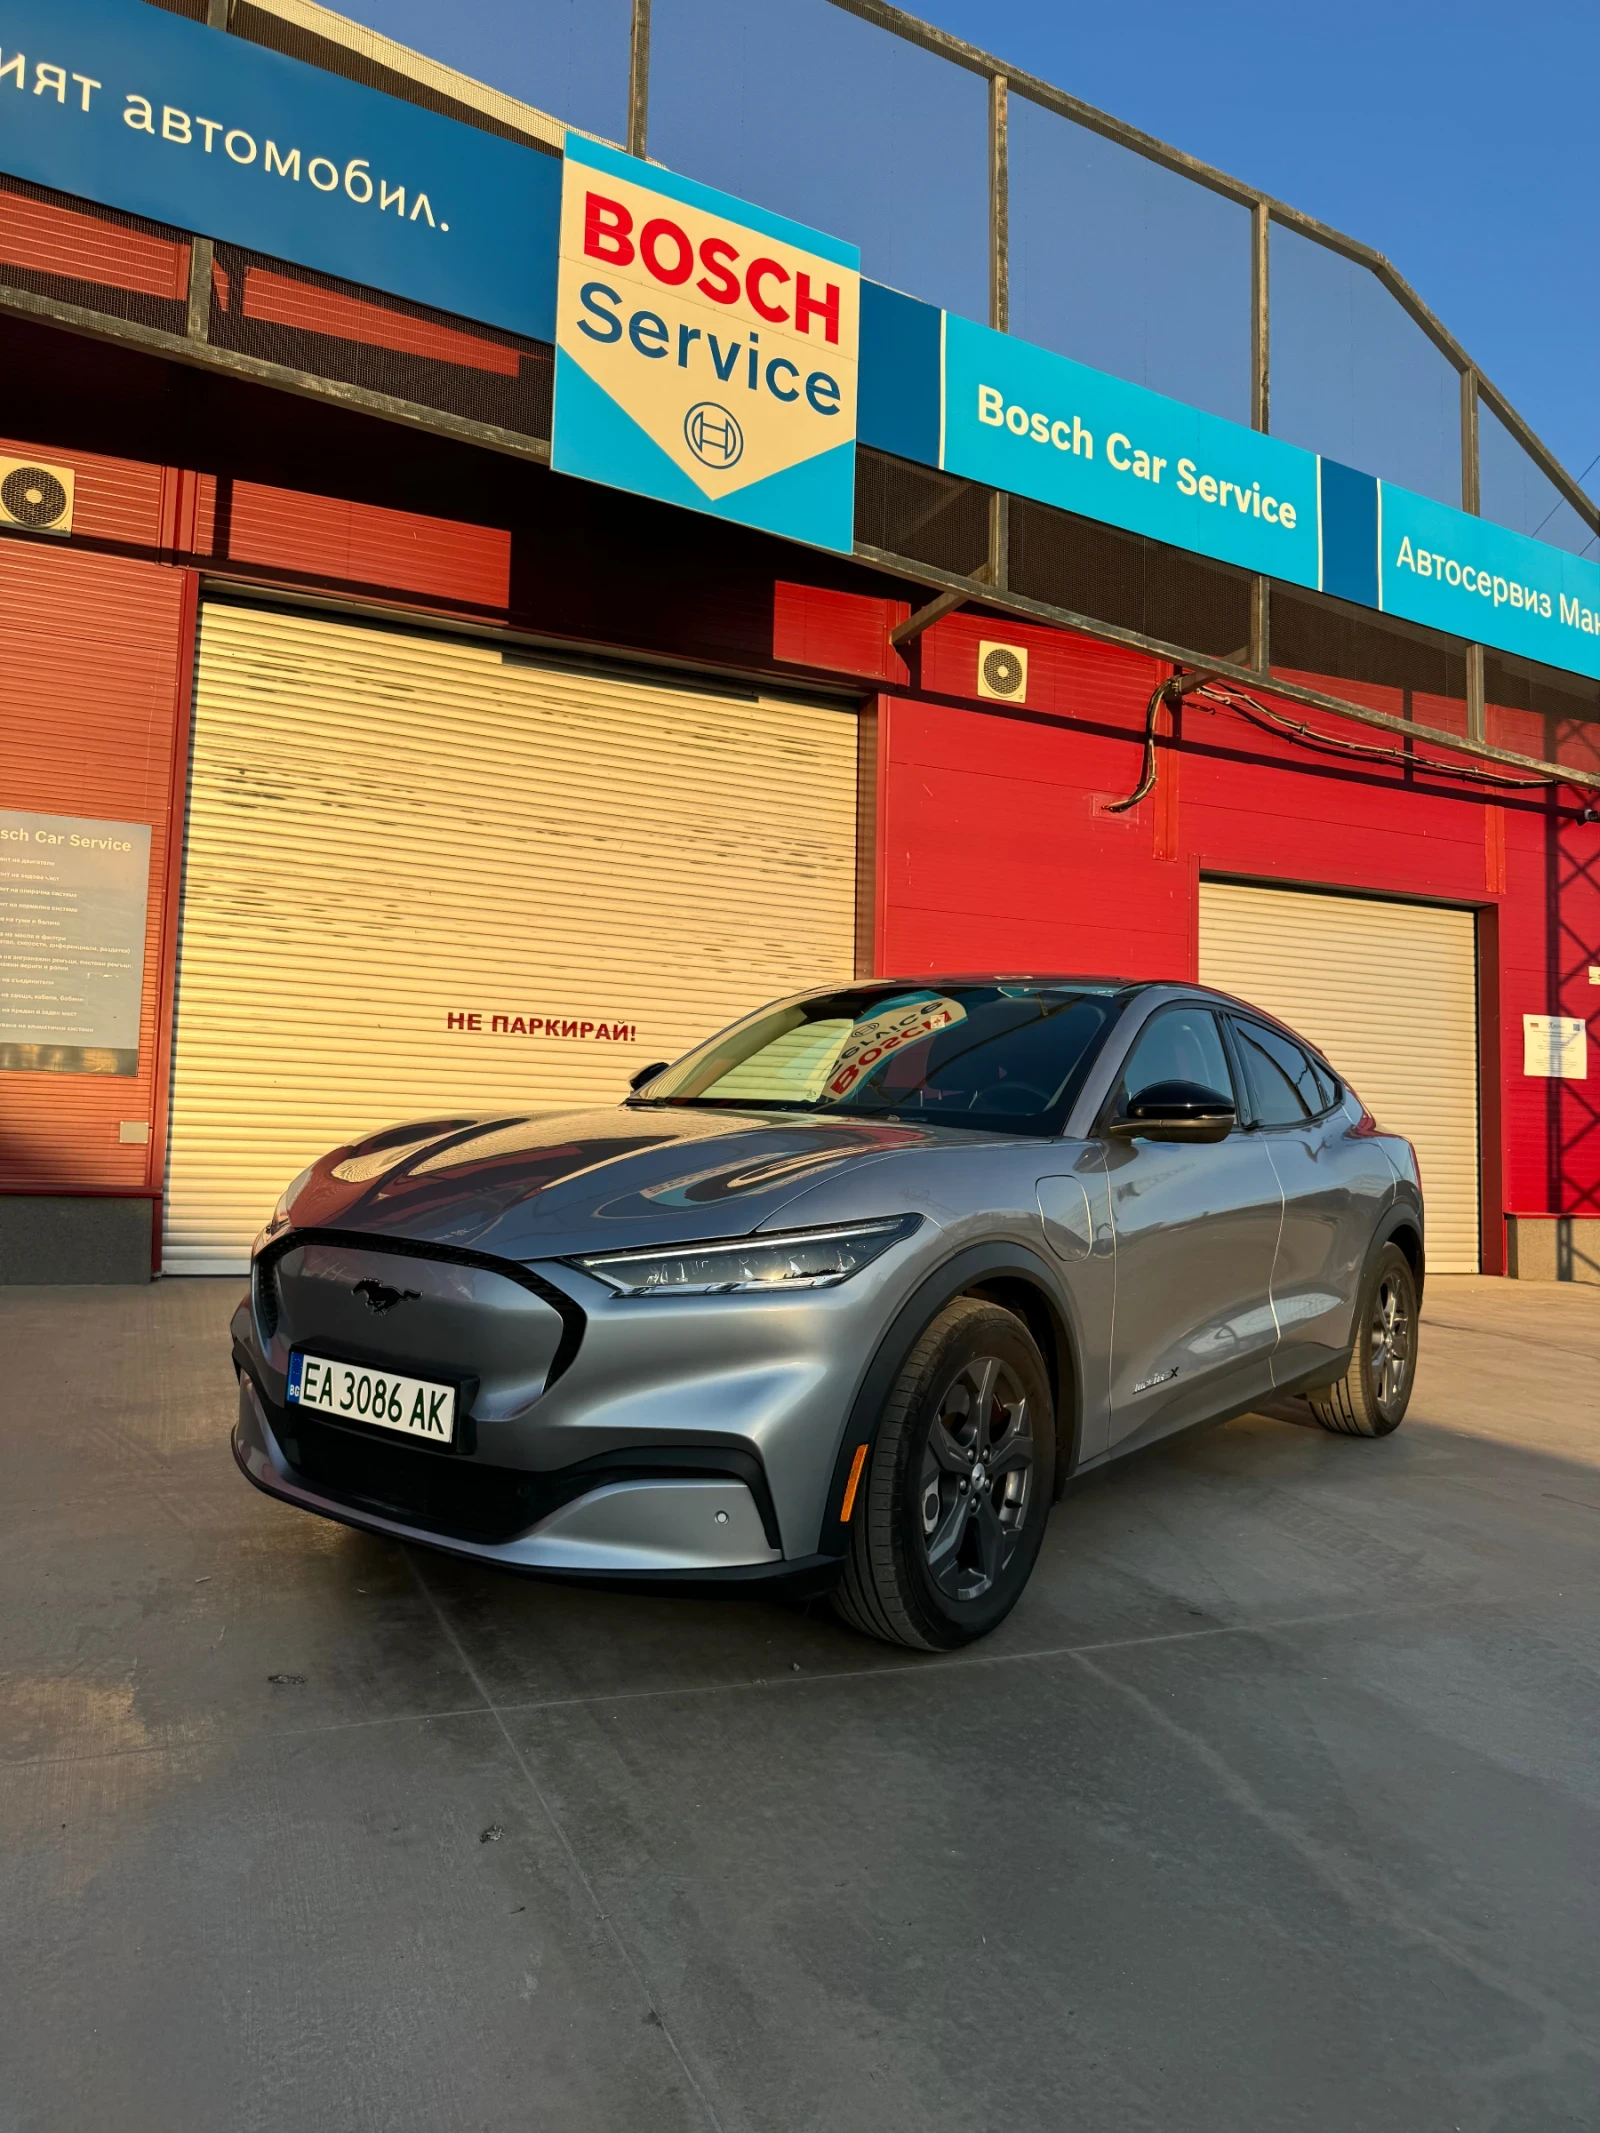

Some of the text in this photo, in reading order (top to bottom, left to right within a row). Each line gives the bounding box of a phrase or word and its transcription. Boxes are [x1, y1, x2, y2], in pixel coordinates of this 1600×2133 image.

[0, 46, 449, 232] ият автомобил.
[583, 190, 841, 346] BOSCH
[576, 281, 842, 416] Service
[978, 384, 1297, 529] Bosch Car Service
[1396, 536, 1552, 618] Автосервиз
[35, 831, 65, 845] Car
[69, 834, 132, 852] Service
[447, 1012, 636, 1042] НЕ ПАРКИРАЙ!
[289, 1384, 300, 1397] BG
[303, 1361, 448, 1435] EA 3086 AK
